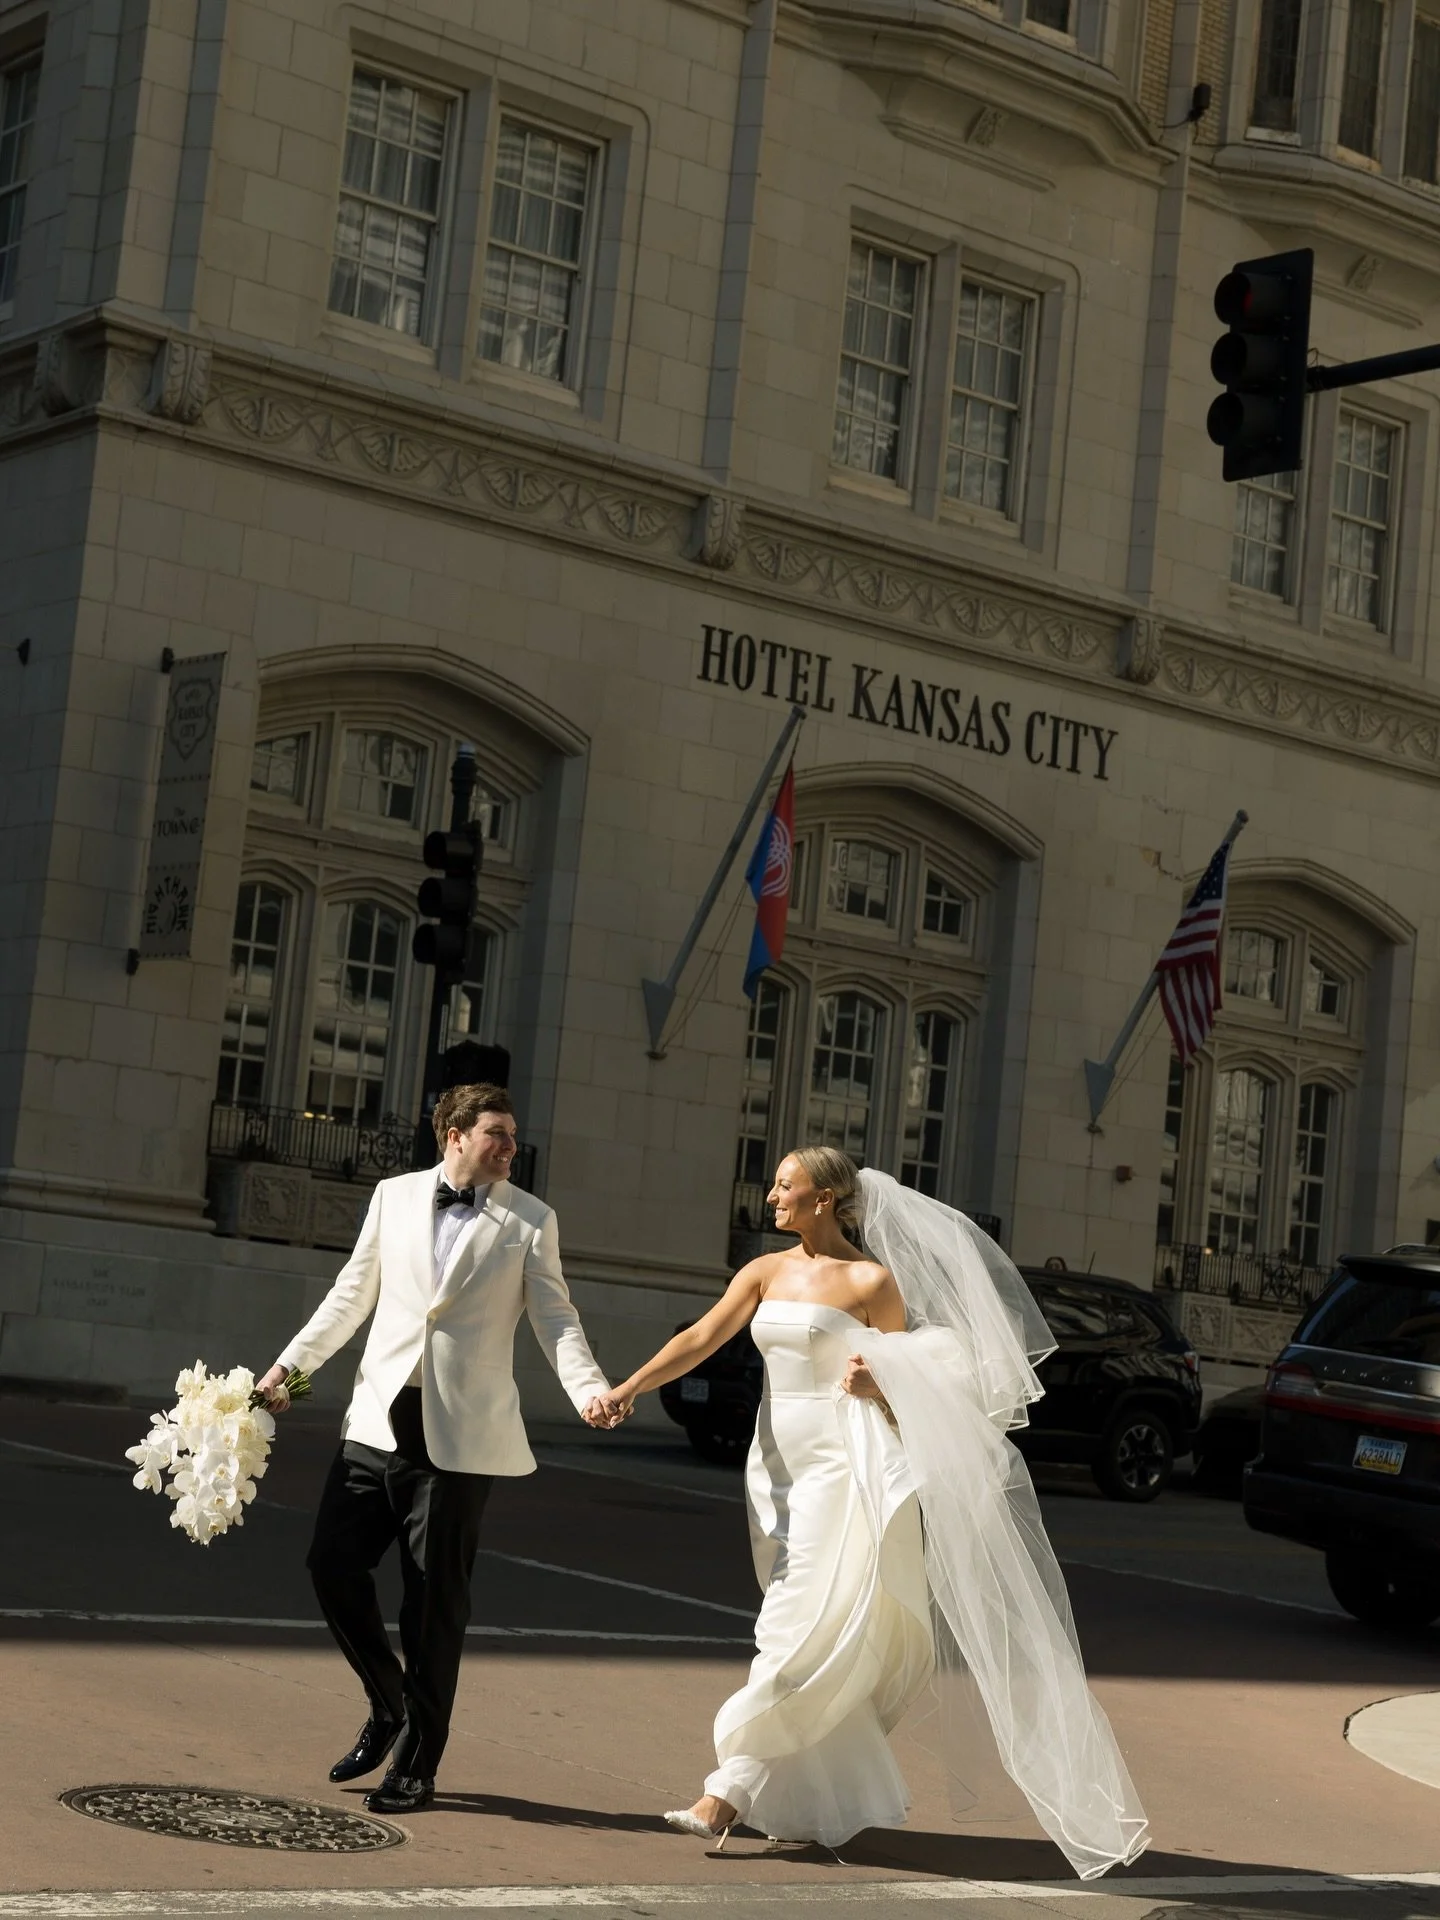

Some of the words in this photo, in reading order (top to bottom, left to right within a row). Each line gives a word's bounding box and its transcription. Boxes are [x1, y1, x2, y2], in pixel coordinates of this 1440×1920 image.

[697, 624, 834, 712] HOTEL
[848, 663, 1011, 756] KANSAS
[1025, 711, 1119, 781] CITY
